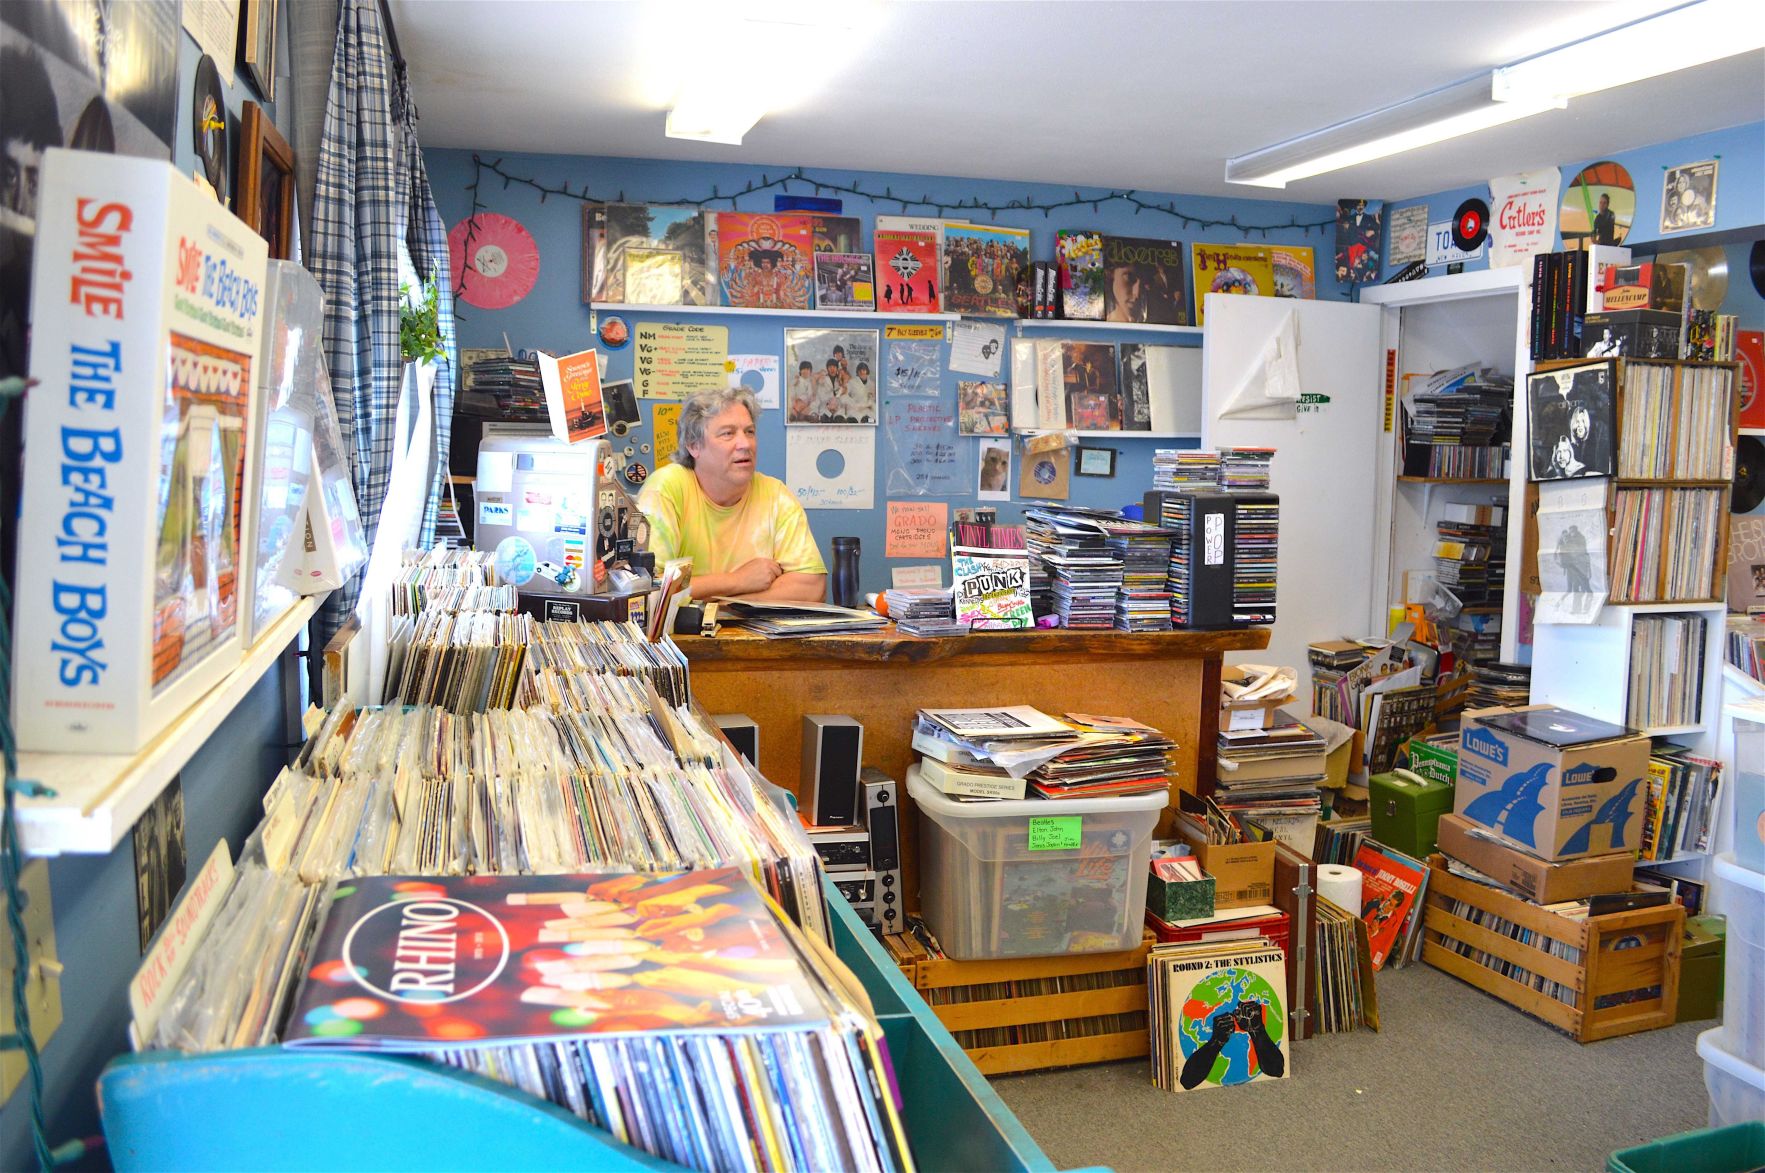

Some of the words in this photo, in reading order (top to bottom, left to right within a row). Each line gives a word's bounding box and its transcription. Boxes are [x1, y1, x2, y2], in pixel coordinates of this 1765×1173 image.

[1500, 200, 1546, 230] Cutler's
[908, 223, 940, 231] WEDDING
[1605, 293, 1647, 304] MELLENCAMP
[639, 332, 656, 340] NM
[639, 344, 658, 353] VG+
[640, 357, 653, 365] VG
[639, 367, 656, 375] VG-
[642, 380, 649, 388] G
[642, 389, 649, 398] F
[56, 425, 124, 566] BEACH
[483, 505, 509, 514] PARKS
[894, 514, 937, 527] GRADO
[895, 533, 932, 541] CARTRIDGES
[959, 524, 990, 548] VINYL
[990, 527, 1024, 549] TIMES
[1205, 515, 1213, 564] POWER
[1214, 516, 1222, 563] POP
[954, 562, 983, 577] CLASH
[964, 569, 1021, 597] PUNK
[1002, 604, 1032, 623] GREEN
[50, 579, 108, 688] BOYS
[1466, 732, 1504, 762] LOWE'S
[1410, 751, 1451, 772] Pennsylvania
[1429, 766, 1450, 785] Dutch
[974, 782, 998, 790] PRESTIGE
[390, 902, 460, 993] RHINO
[1173, 960, 1204, 973] ROUND
[1204, 960, 1213, 969] 2:
[1214, 958, 1232, 968] THE
[1233, 953, 1283, 967] STYLISTICS
